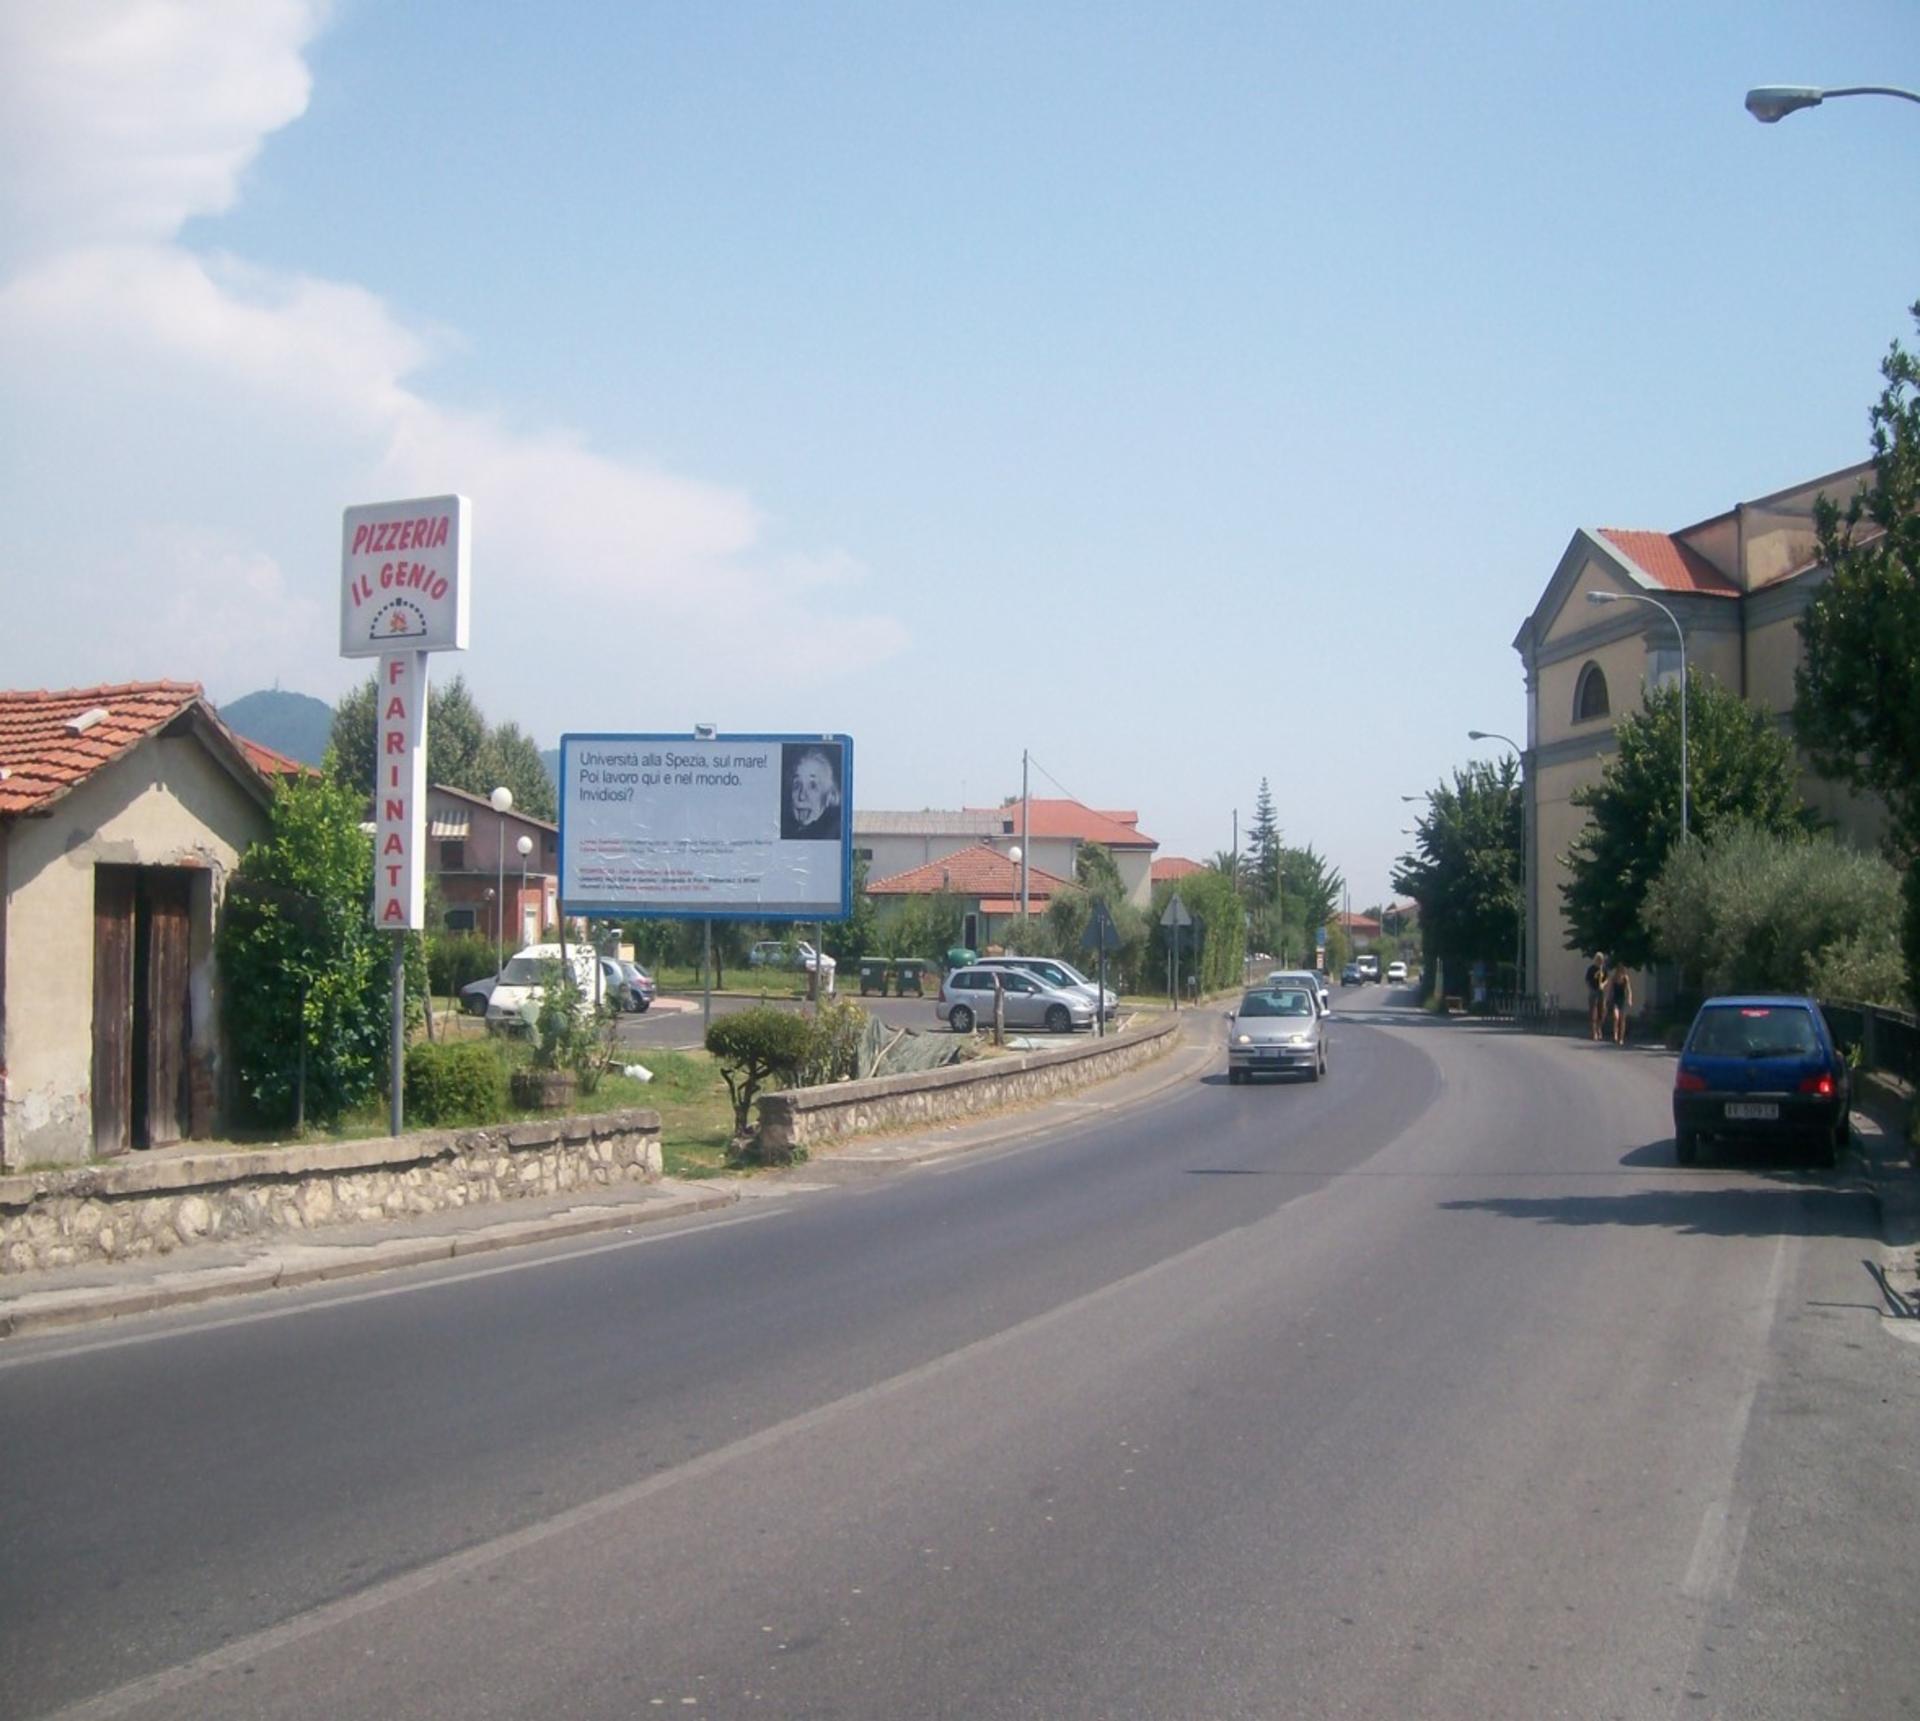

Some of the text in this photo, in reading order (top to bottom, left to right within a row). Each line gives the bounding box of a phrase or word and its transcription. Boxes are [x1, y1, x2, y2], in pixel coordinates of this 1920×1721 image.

[352, 516, 449, 555] PIZZERIA
[352, 561, 449, 607] IL GENIO
[580, 751, 638, 767] Università
[641, 753, 662, 767] alla
[712, 754, 731, 768] sul
[733, 753, 768, 769] mare!
[383, 661, 406, 922] FARINATA
[580, 768, 599, 784] Poi
[602, 769, 639, 784] lavoro
[641, 769, 661, 787] qui
[674, 770, 693, 785] nel
[695, 771, 742, 786] mondo.
[580, 786, 634, 802] Invidiosi?
